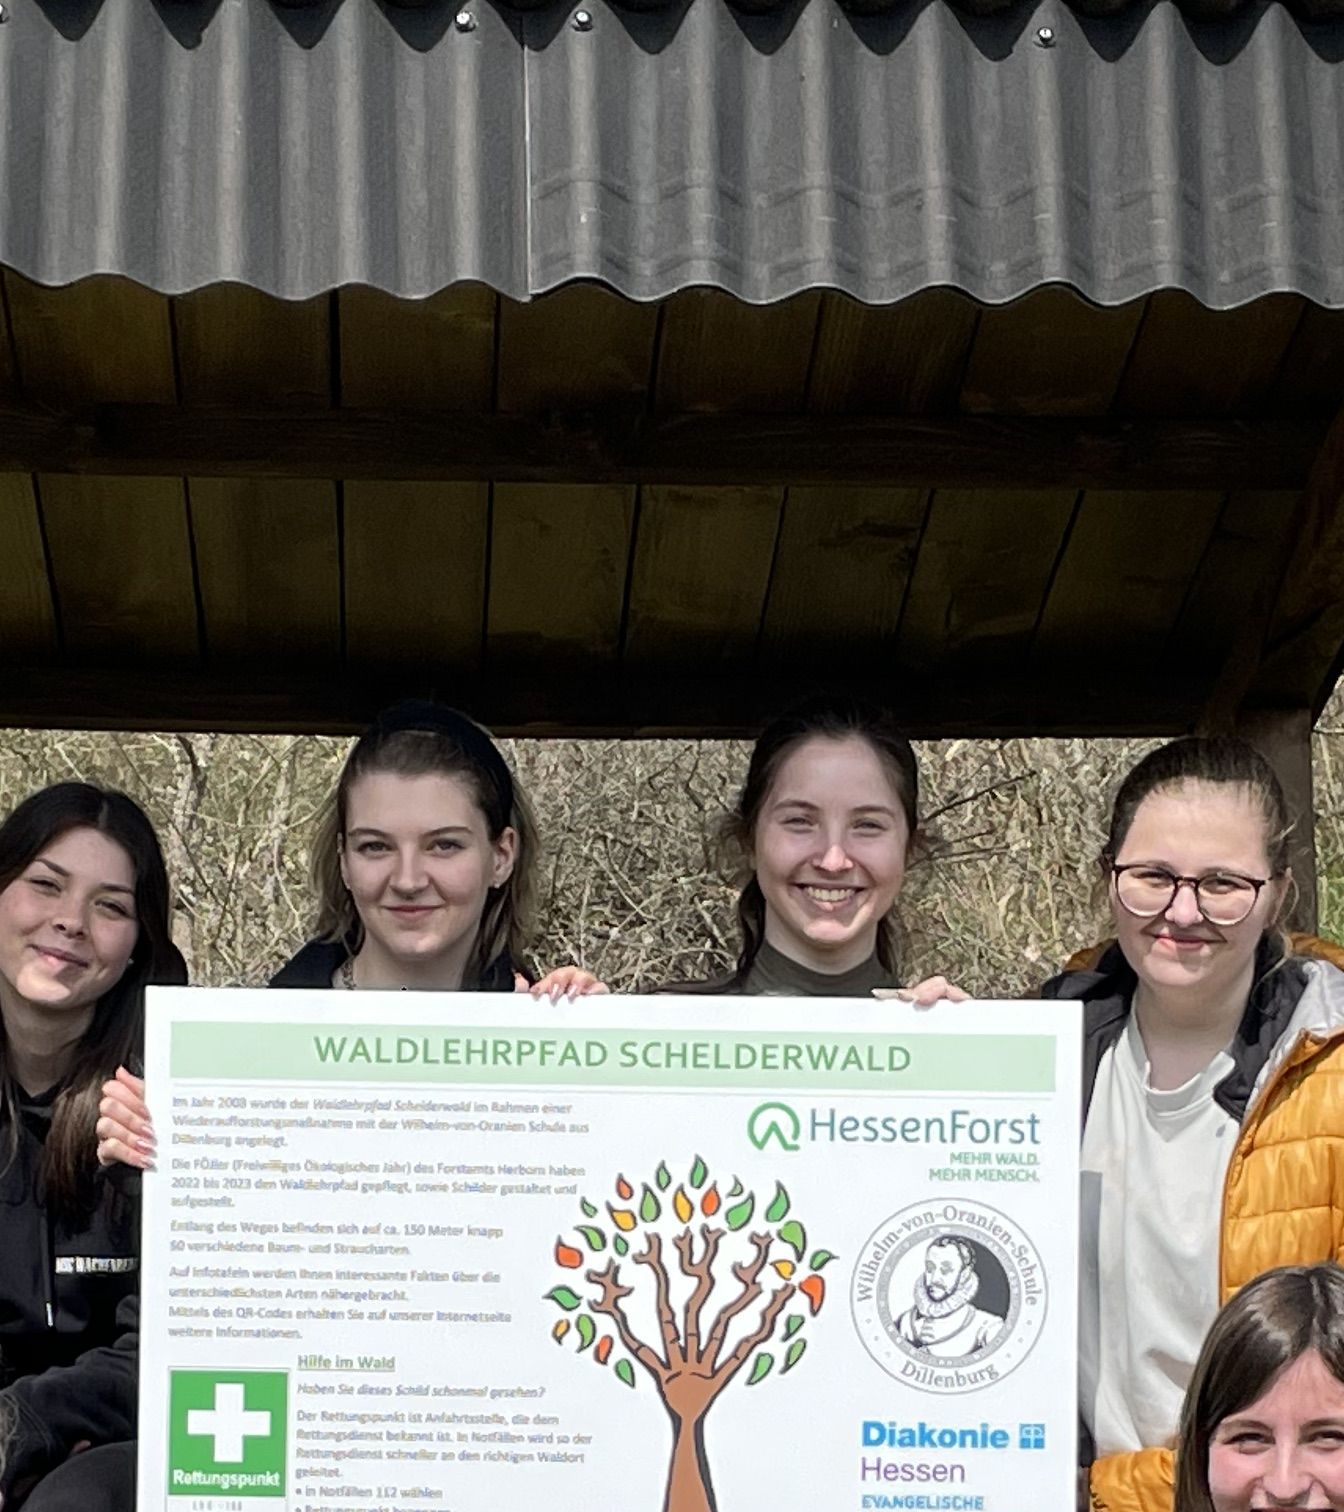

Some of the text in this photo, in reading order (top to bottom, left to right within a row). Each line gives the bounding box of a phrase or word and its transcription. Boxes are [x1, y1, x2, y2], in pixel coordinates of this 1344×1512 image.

[314, 1035, 911, 1072] WALDLEHRPFAD SCHELDERWALD
[250, 1099, 286, 1109] wurde
[290, 1099, 308, 1109] der
[313, 1099, 391, 1113] Waldlehrpfad
[394, 1100, 471, 1112] Schelderwald
[474, 1102, 488, 1112] im
[491, 1102, 539, 1113] Rahmen
[542, 1103, 572, 1114] einer
[355, 1118, 375, 1129] mit
[378, 1119, 398, 1130] der
[529, 1121, 566, 1132] Schule
[569, 1123, 589, 1133] aus
[810, 1108, 1041, 1144] HessenForst
[172, 1133, 232, 1147] Dillenburg
[950, 1152, 1039, 1166] MEHR WALD.
[172, 1158, 190, 1170] Die
[382, 1161, 411, 1174] Jahr)
[414, 1162, 434, 1174] des
[437, 1162, 495, 1175] Forstamts
[497, 1164, 545, 1175] Herborn
[549, 1164, 585, 1176] haben
[929, 1168, 1040, 1182] MEHR MENSCH.
[172, 1177, 199, 1189] 2022
[203, 1178, 220, 1189] bis
[223, 1178, 251, 1190] 2023
[255, 1179, 276, 1190] den
[280, 1179, 358, 1192] Waldlehrpfad
[416, 1182, 449, 1193] sowie
[452, 1182, 498, 1194] Schilder
[501, 1183, 551, 1196] gestaltet
[554, 1184, 577, 1195] und
[170, 1220, 214, 1234] Entlang
[217, 1221, 237, 1232] des
[240, 1221, 279, 1235] Weges
[282, 1222, 333, 1233] befinden
[337, 1223, 359, 1234] sich
[362, 1223, 381, 1234] auf
[428, 1225, 464, 1236] Meter
[467, 1225, 503, 1239] knapp
[187, 1241, 264, 1252] verschiedene
[309, 1243, 331, 1253] und
[857, 1205, 1043, 1306] Wilhelm-von-Oranien-Schule
[169, 1266, 190, 1277] Auf
[252, 1268, 296, 1279] werden
[336, 1269, 407, 1281] interessante
[410, 1270, 449, 1282] Fakten
[452, 1271, 480, 1282] über
[482, 1271, 500, 1282] die
[285, 1289, 317, 1299] Arten
[169, 1306, 511, 1323] Mittels des QR-Codes erhalten Sie auf unserer Internetseite
[168, 1327, 213, 1338] weitere
[297, 1354, 395, 1369] Hilfe im Wald
[900, 1360, 999, 1388] Dillenburg
[297, 1383, 335, 1395] Haben
[337, 1384, 354, 1395] Sie
[357, 1384, 392, 1396] dieses
[395, 1384, 430, 1396] Schild
[297, 1410, 317, 1421] Der
[320, 1411, 405, 1424] Rettungspunkt
[408, 1412, 422, 1422] ist
[511, 1414, 530, 1424] die
[532, 1414, 559, 1425] dem
[297, 1429, 383, 1442] Rettungsdienst
[386, 1430, 433, 1441] bekannt
[527, 1433, 553, 1443] wird
[557, 1436, 570, 1444] so
[573, 1433, 592, 1444] der
[862, 1421, 1009, 1448] Diakonie
[296, 1448, 584, 1463] Rettungsdienst schneller an den richtigen Waldort
[861, 1457, 965, 1483] Hessen
[173, 1469, 280, 1489] Rettungspunkt
[305, 1486, 316, 1496] in
[862, 1495, 984, 1510] EVANGELISCHE
